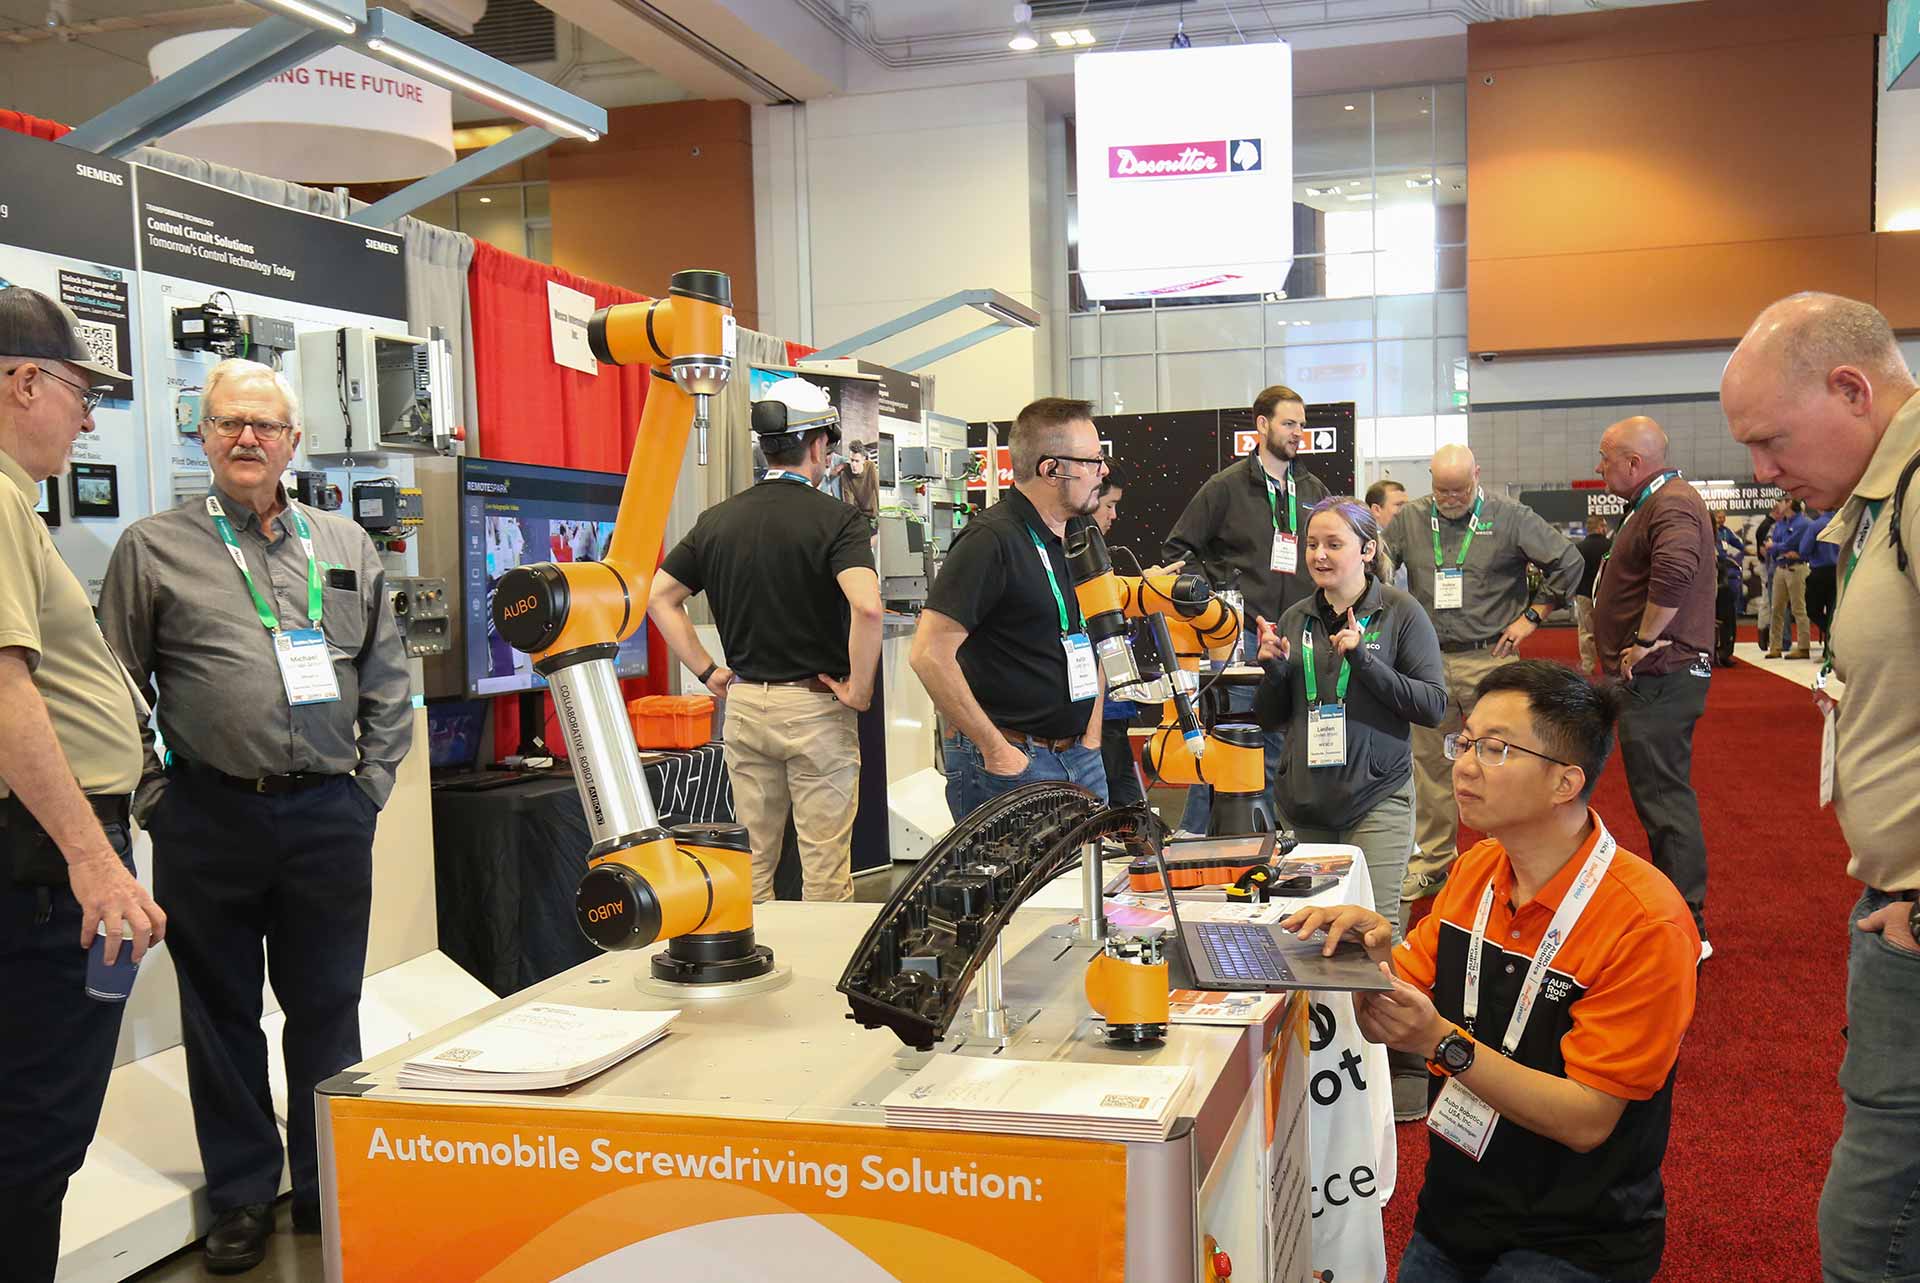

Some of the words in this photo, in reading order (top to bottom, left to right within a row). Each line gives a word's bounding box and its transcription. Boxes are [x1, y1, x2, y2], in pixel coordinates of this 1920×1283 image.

[315, 69, 355, 89] THE
[361, 75, 423, 103] FUTURE
[1117, 147, 1218, 175] Desoutter
[76, 164, 123, 186] SIEMENS
[147, 217, 182, 235] Control
[184, 227, 213, 244] Circuit
[214, 234, 254, 254] Solutions
[365, 239, 398, 255] SIEMENS
[148, 234, 197, 256] Tomorrow's
[198, 247, 227, 263] Control
[228, 253, 271, 276] Technology
[272, 264, 295, 280] Today
[467, 481, 508, 494] REMOTESPARK
[1698, 487, 1740, 500] OLUTIONS
[1742, 487, 1759, 498] FOR
[1705, 500, 1728, 511] YOUR
[1730, 499, 1751, 511] BULK
[504, 594, 537, 621] AUBO
[560, 685, 584, 752] COLLABORATIVE
[580, 756, 595, 784] ROBOT
[588, 899, 623, 923] AUBO
[1544, 992, 1560, 1002] USA
[1459, 1105, 1484, 1127] Robotics
[366, 1126, 580, 1172] Automobile
[590, 1140, 849, 1198] Screwdriving
[859, 1155, 1044, 1203] Solution:
